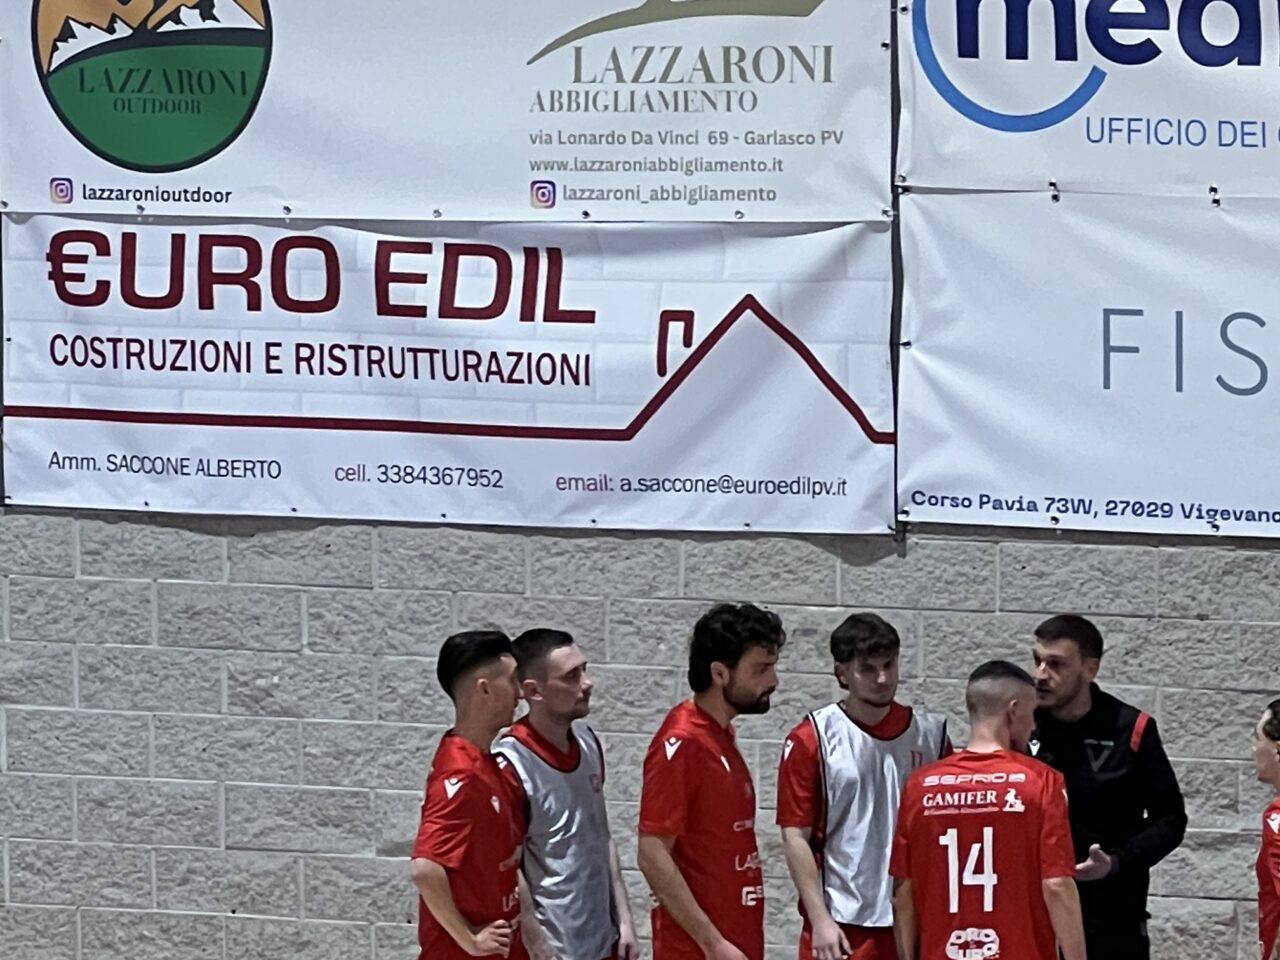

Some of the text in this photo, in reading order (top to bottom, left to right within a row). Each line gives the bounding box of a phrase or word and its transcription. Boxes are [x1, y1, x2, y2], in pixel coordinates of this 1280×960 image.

[572, 45, 835, 85] LAZZARONI
[79, 66, 249, 97] LAZZARONI
[112, 96, 202, 115] OUTDOOR
[528, 90, 759, 114] ABBIGLIAMENTO
[529, 131, 554, 146] via
[557, 130, 628, 146] Lonardo
[631, 131, 654, 146] Da
[657, 130, 700, 146] Vinci
[707, 131, 729, 146] 69
[744, 130, 816, 147] Garlasco
[820, 131, 845, 146] PV
[1085, 116, 1207, 147] UFFICIO
[1217, 120, 1267, 149] DEI
[528, 157, 784, 176] www.lazzaroniabbigliamento.it
[82, 183, 233, 204] lazzaronioutdoor
[562, 184, 777, 206] lazzaroni_abbigliamento
[46, 230, 597, 324] €URO EDIL
[49, 333, 591, 387] COSTRUZIONI E RISTRUTTURAZIONI
[48, 451, 848, 499] Amm. SACCONE ALBERTO cell. 3384367952 email: a.saccone@euroedilpv.it
[910, 490, 973, 509] Corso
[978, 493, 1040, 513] Pavia
[1043, 496, 1099, 519] 73W,
[1104, 499, 1174, 519] 27029
[922, 789, 998, 808] GAMIFER
[938, 826, 998, 914] 14
